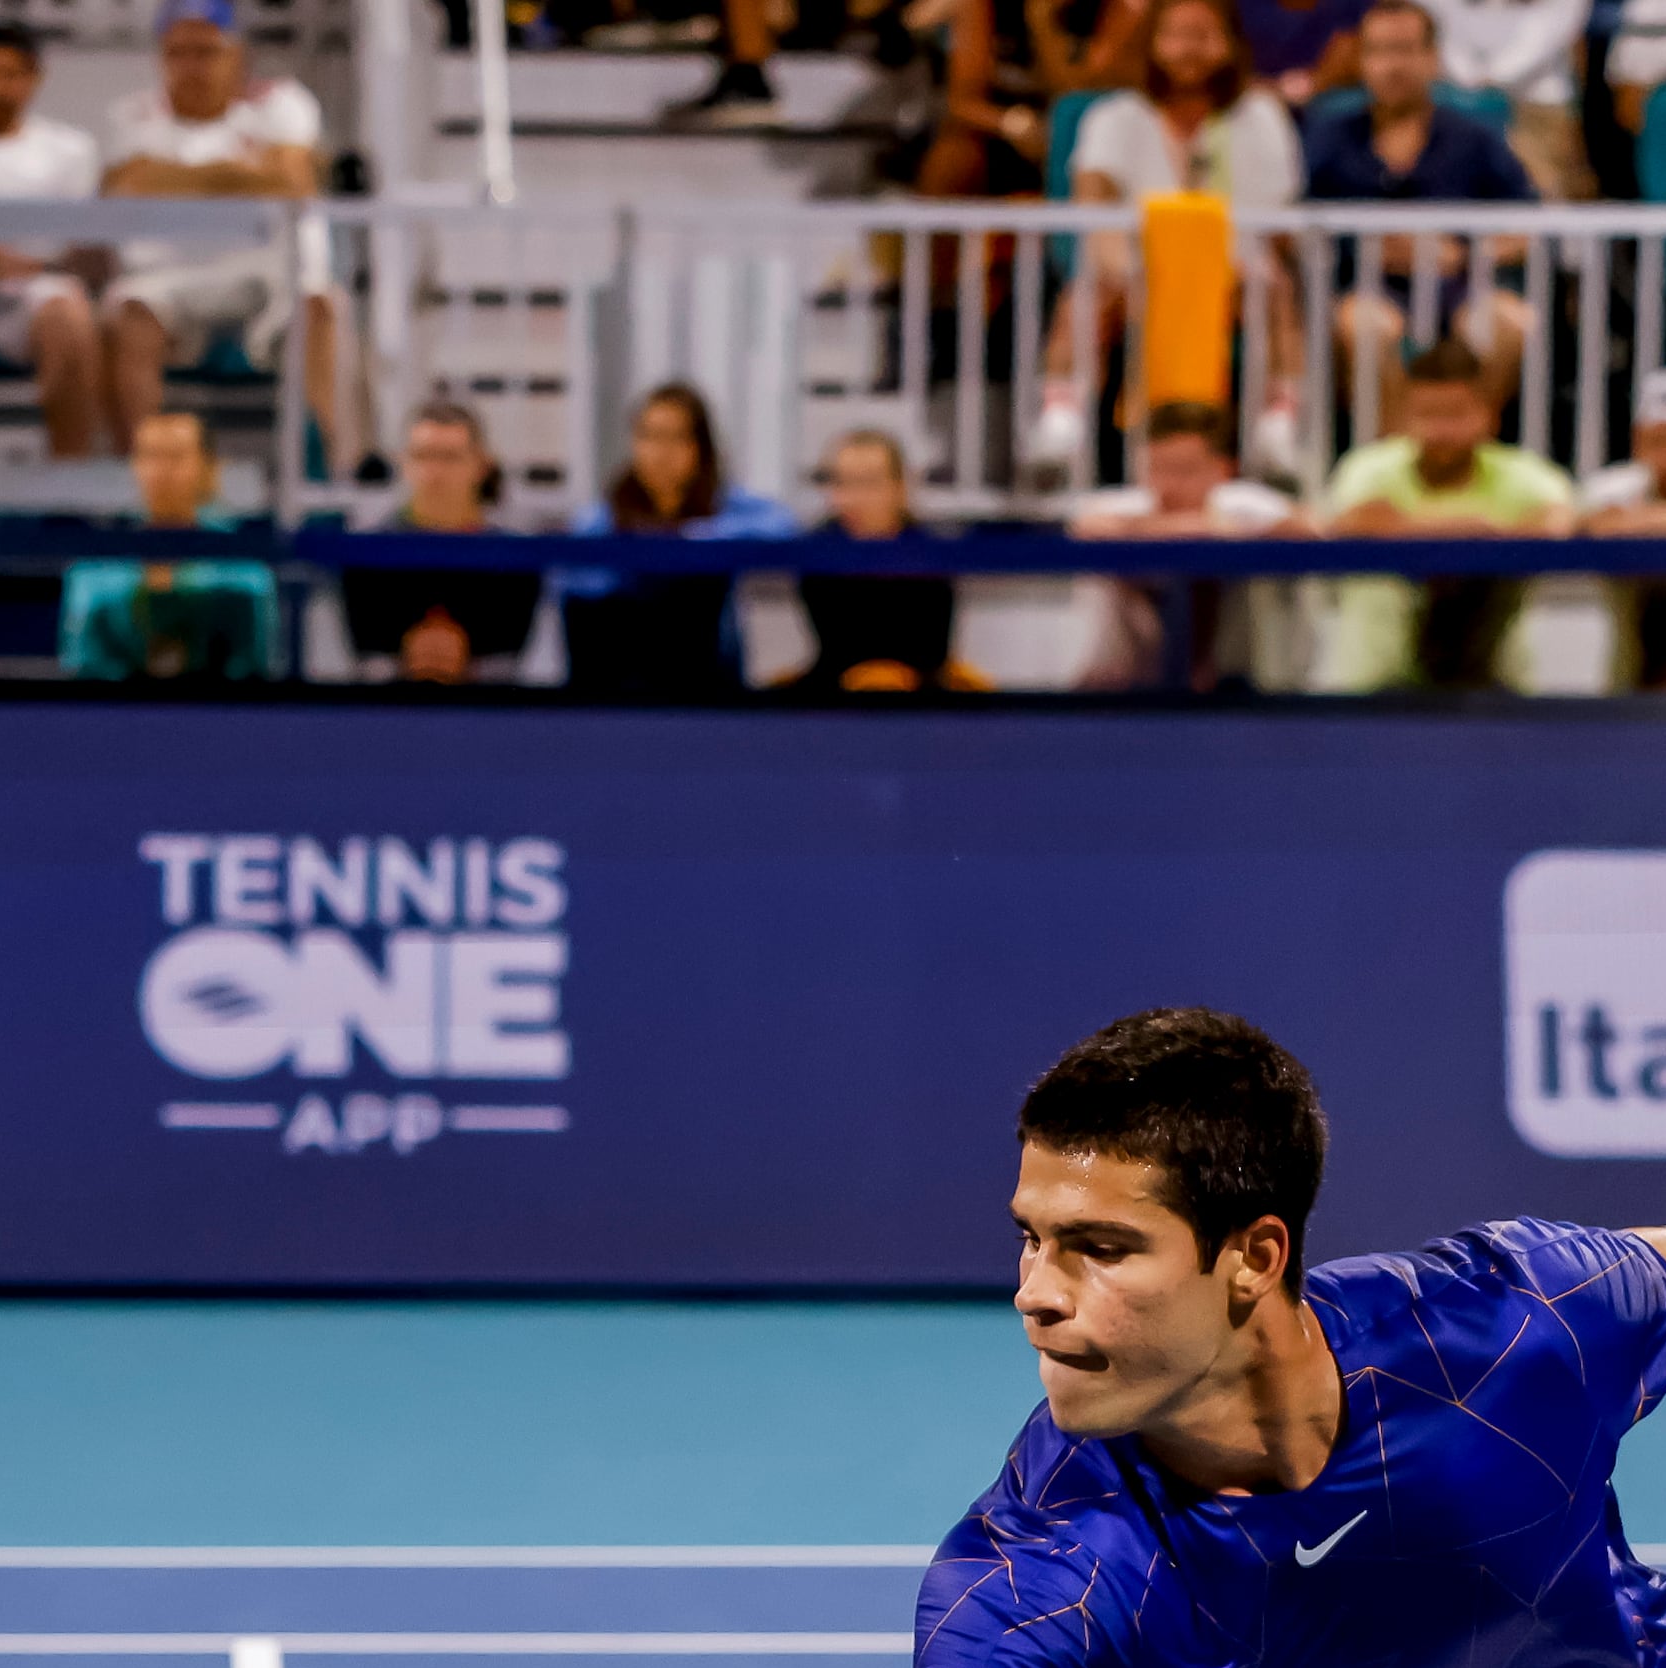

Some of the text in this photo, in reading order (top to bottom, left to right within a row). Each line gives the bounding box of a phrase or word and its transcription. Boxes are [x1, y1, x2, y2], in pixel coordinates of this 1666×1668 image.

[140, 834, 568, 926] TENNIS
[140, 928, 571, 1080] ONE
[284, 1093, 443, 1155] APP
